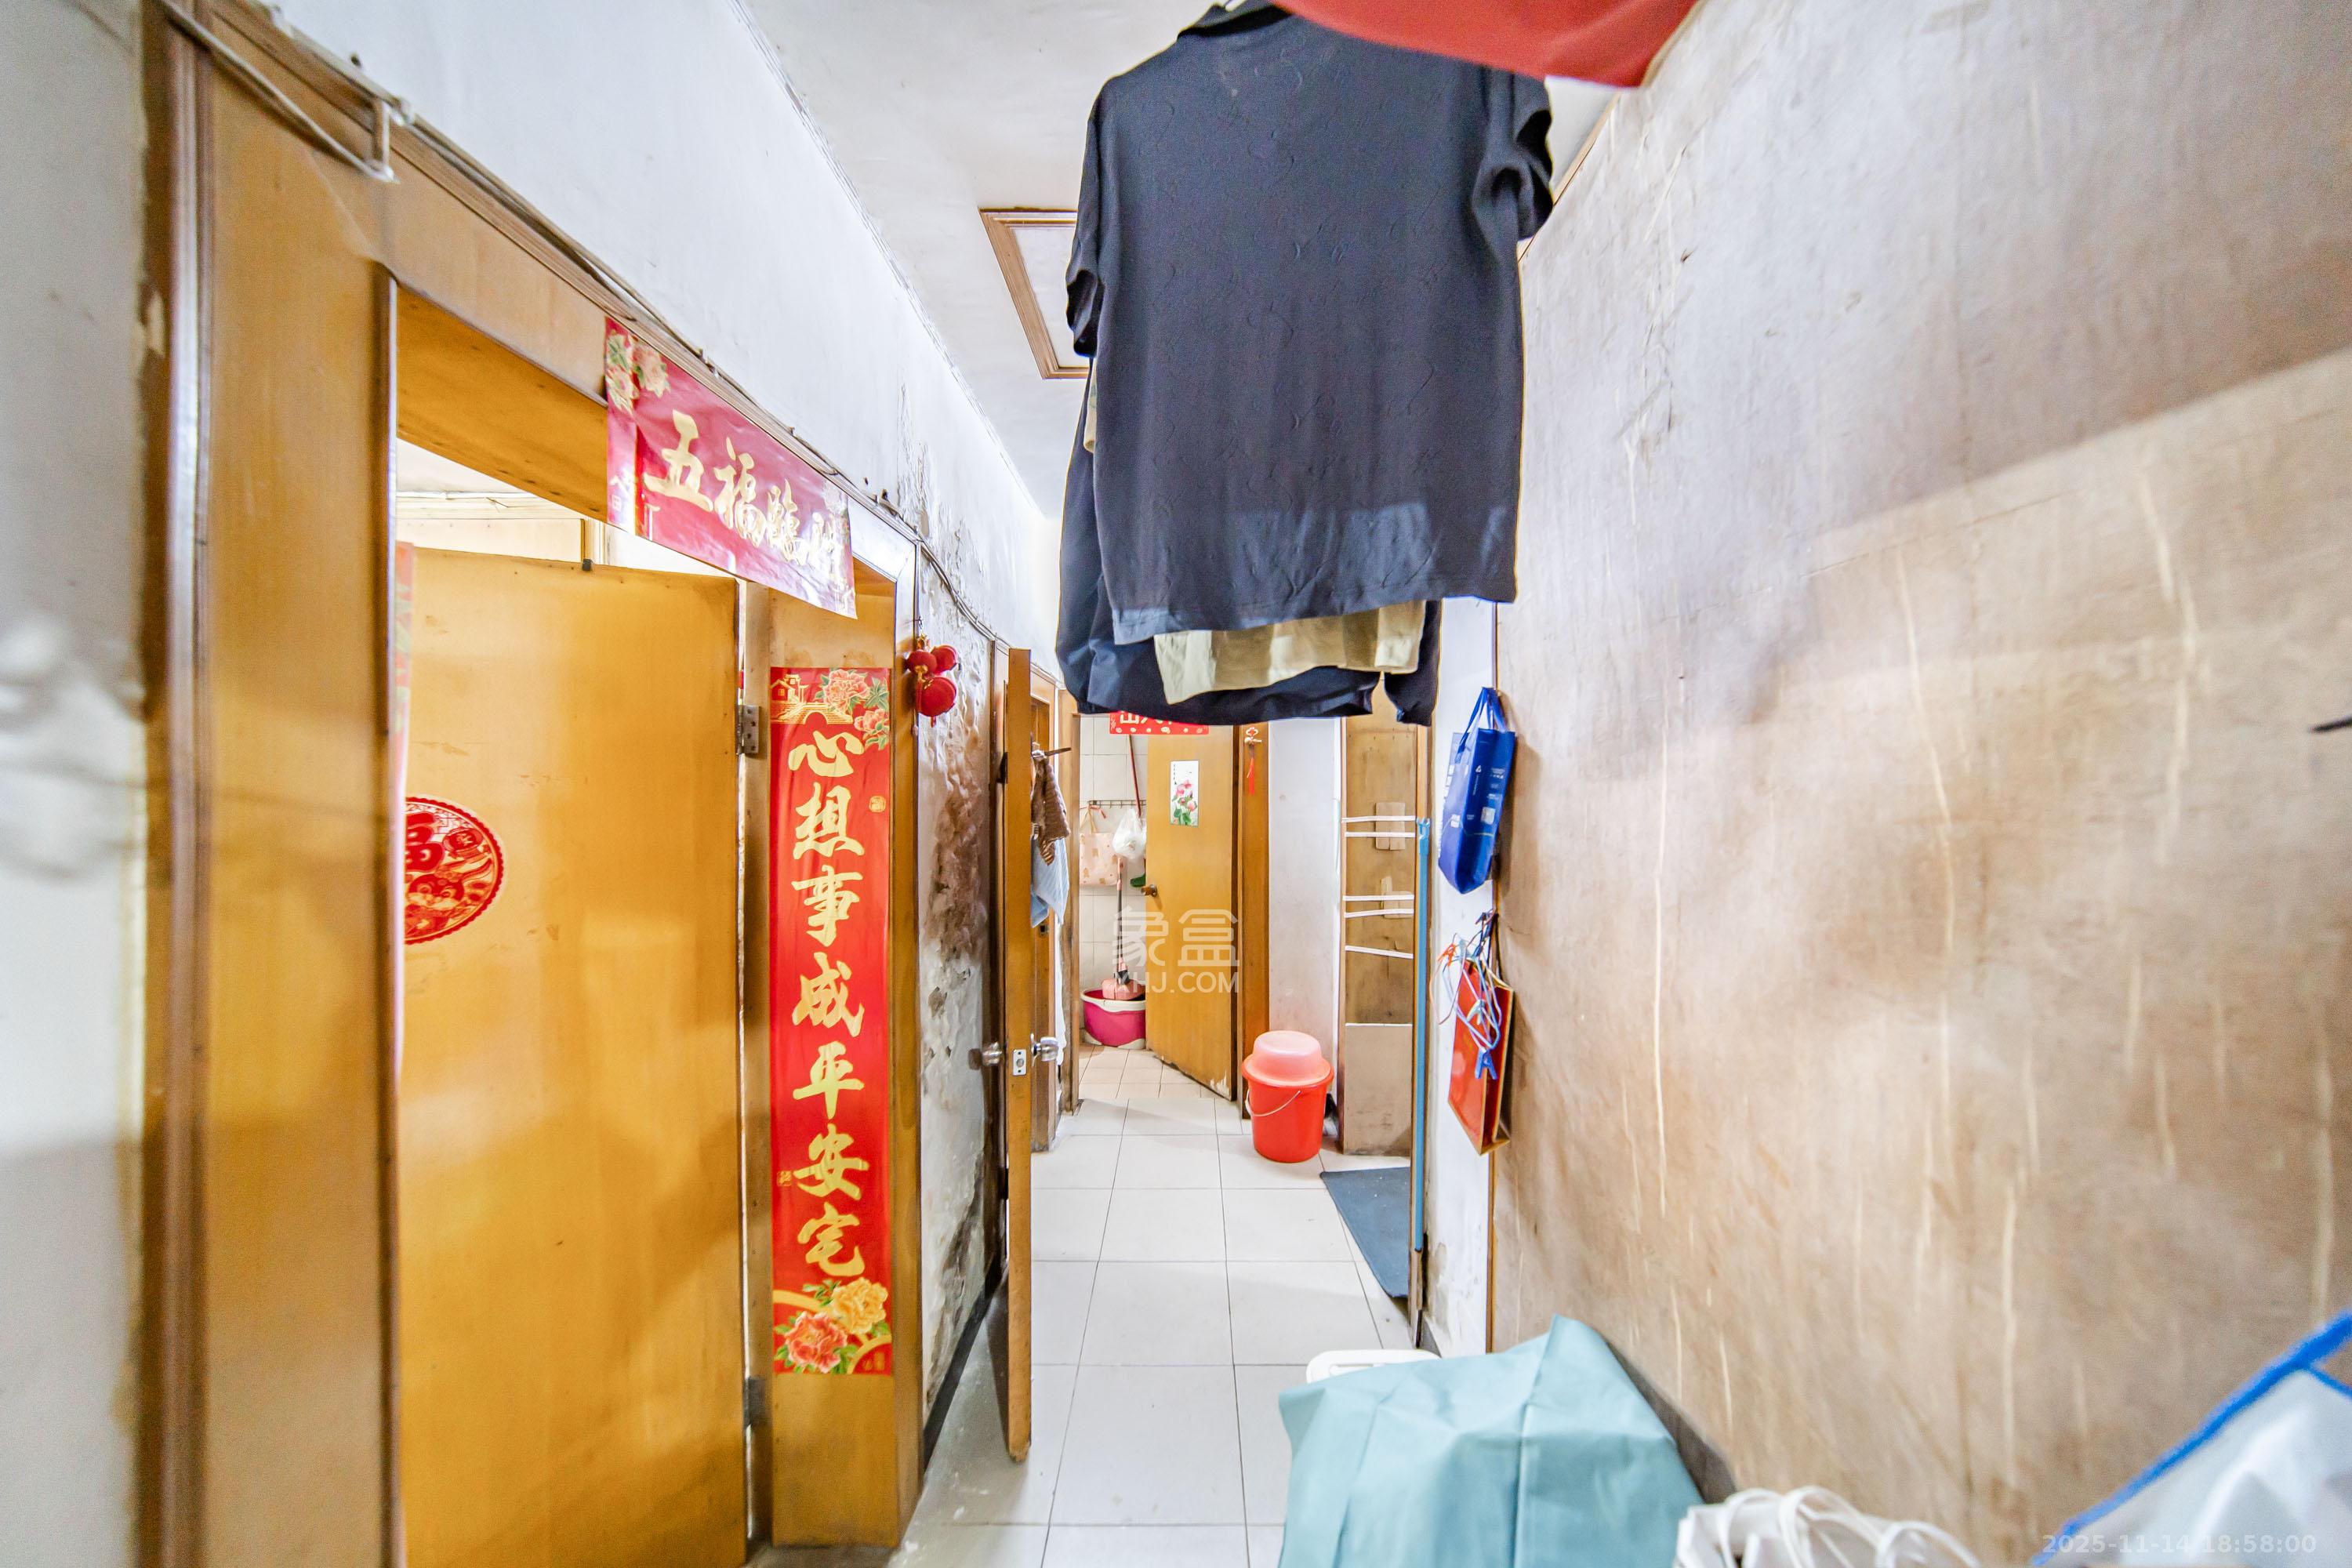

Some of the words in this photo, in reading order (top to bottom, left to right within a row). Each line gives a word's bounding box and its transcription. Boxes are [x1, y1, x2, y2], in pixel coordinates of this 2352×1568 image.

[788, 731, 869, 1276] 心想事成平安宅
